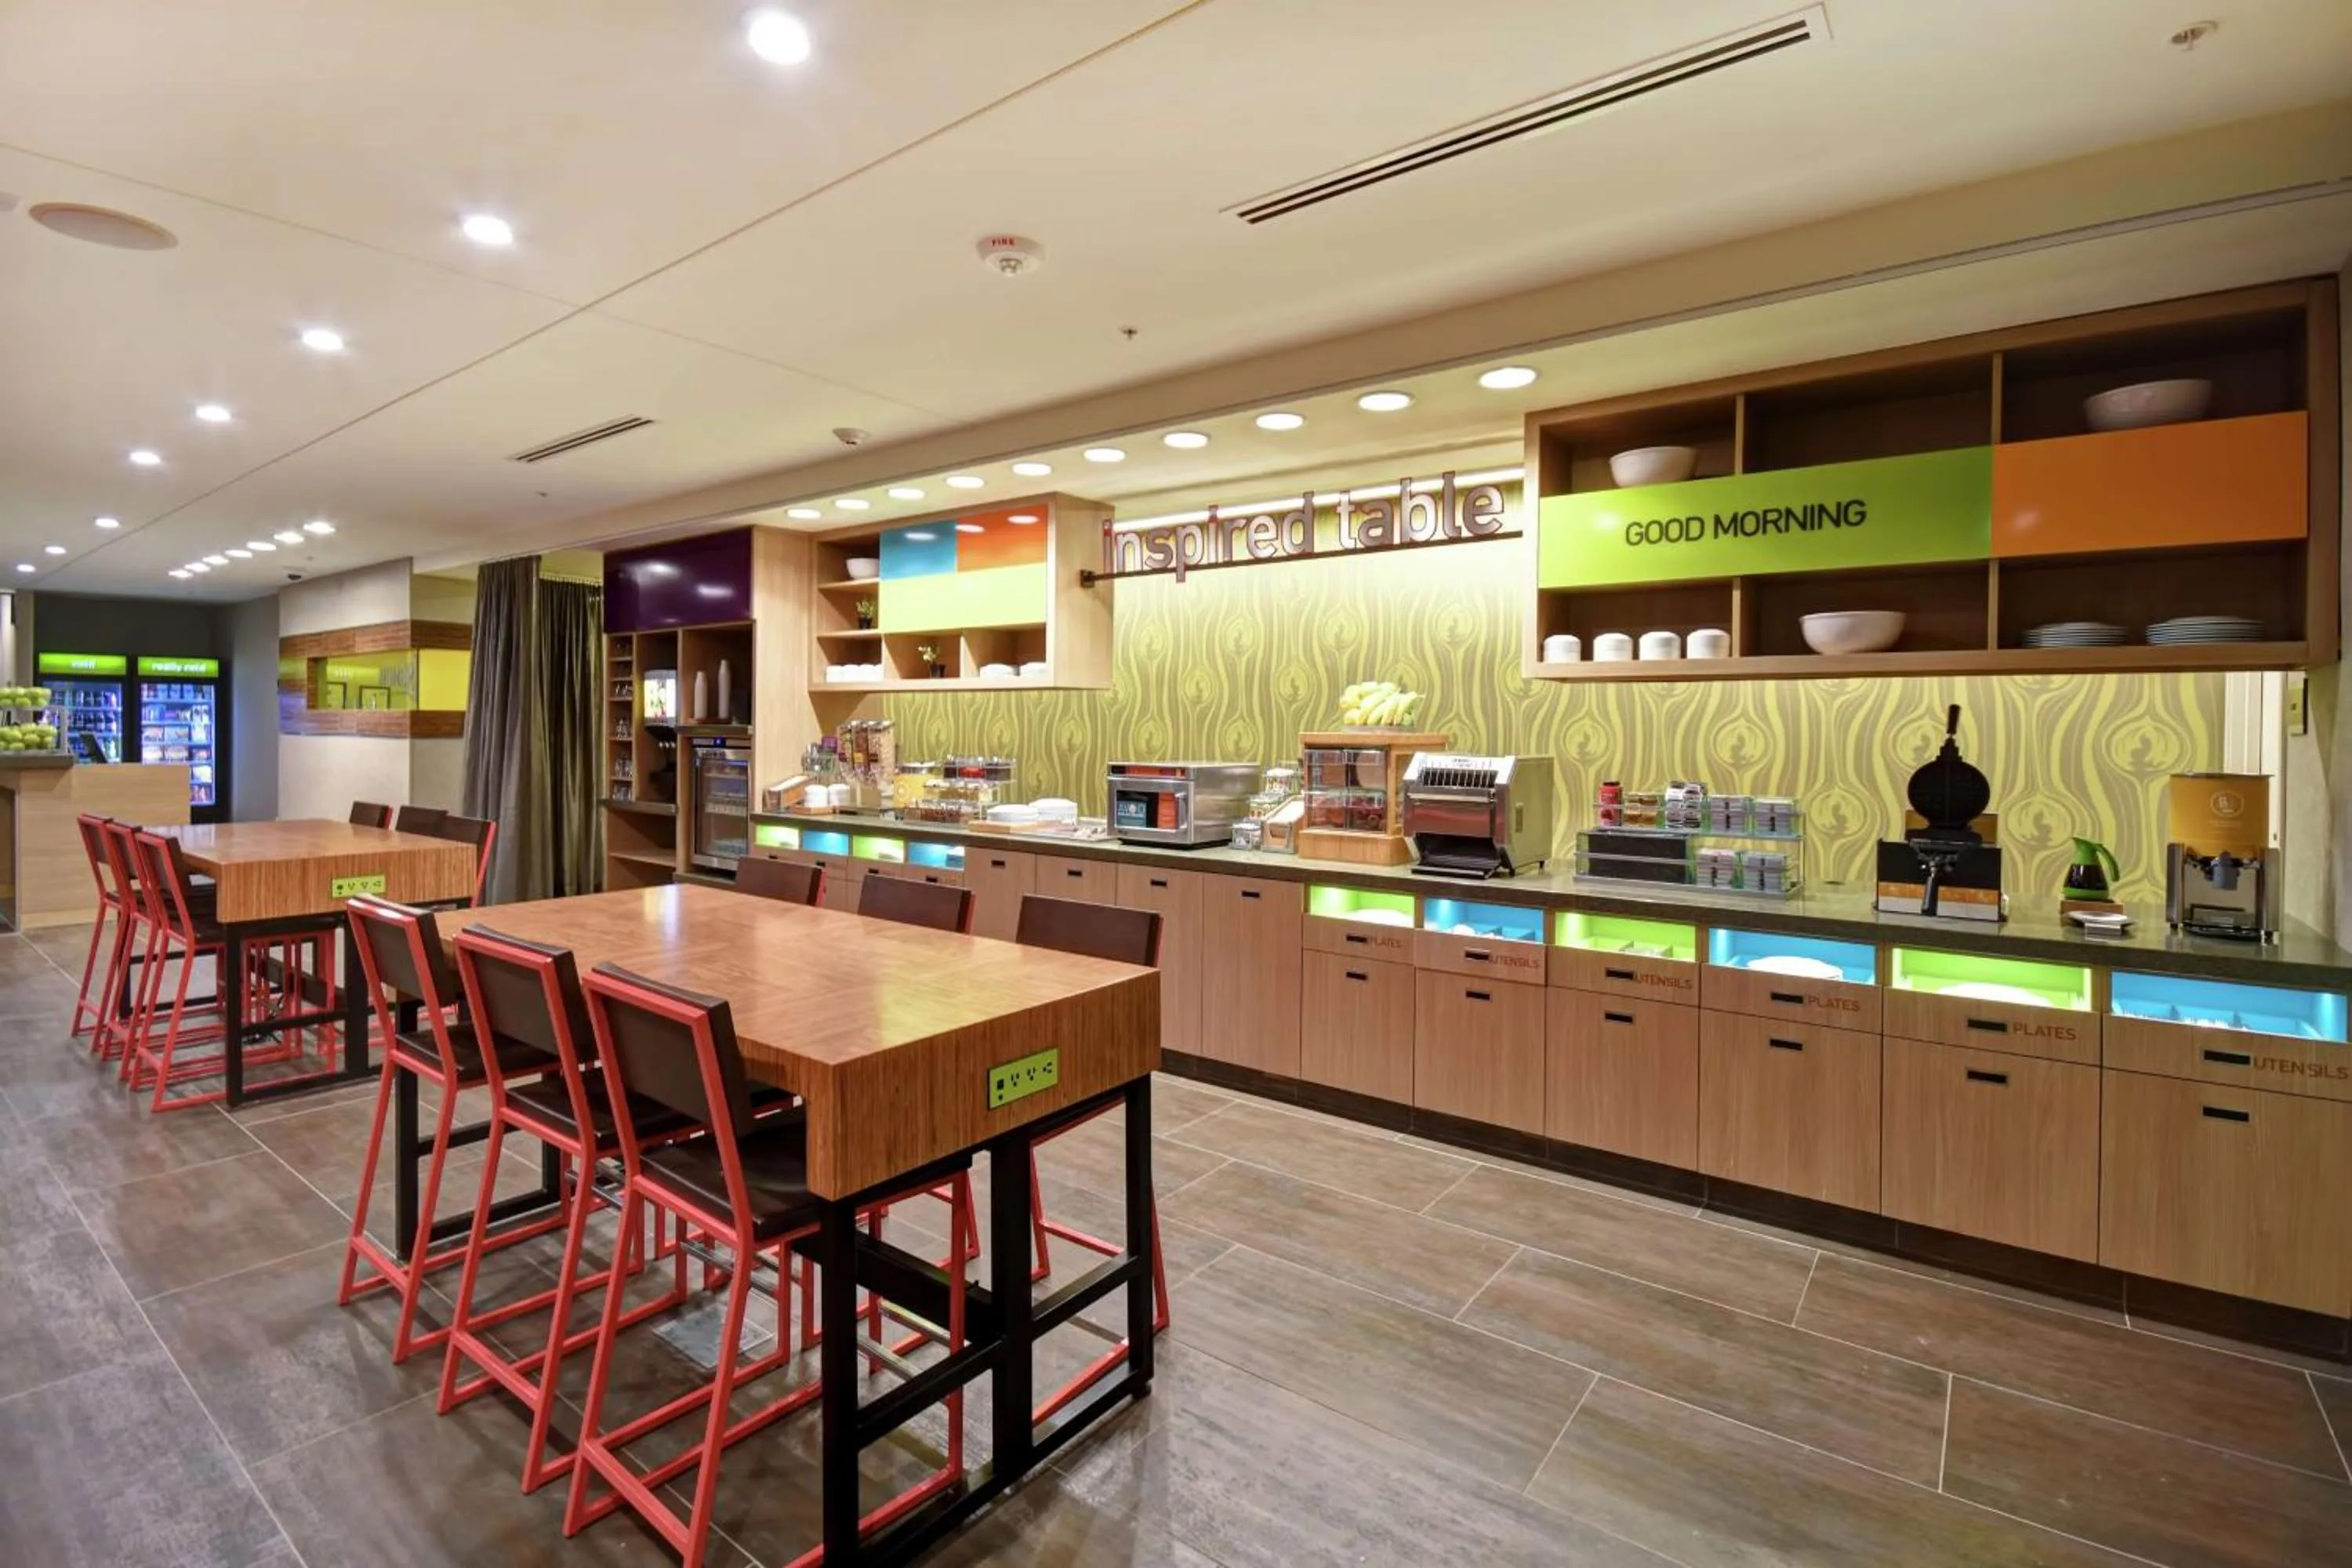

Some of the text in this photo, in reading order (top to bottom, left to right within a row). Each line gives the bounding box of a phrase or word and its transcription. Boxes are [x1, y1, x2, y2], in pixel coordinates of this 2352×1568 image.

[1102, 470, 1504, 583] inspired table
[1625, 499, 1867, 546] GOOD MORNING
[1635, 971, 1693, 989] UTENSILS
[1808, 995, 1860, 1011] PLATES
[2013, 1022, 2077, 1040] PLATES
[2253, 1056, 2349, 1080] UTENSILS
